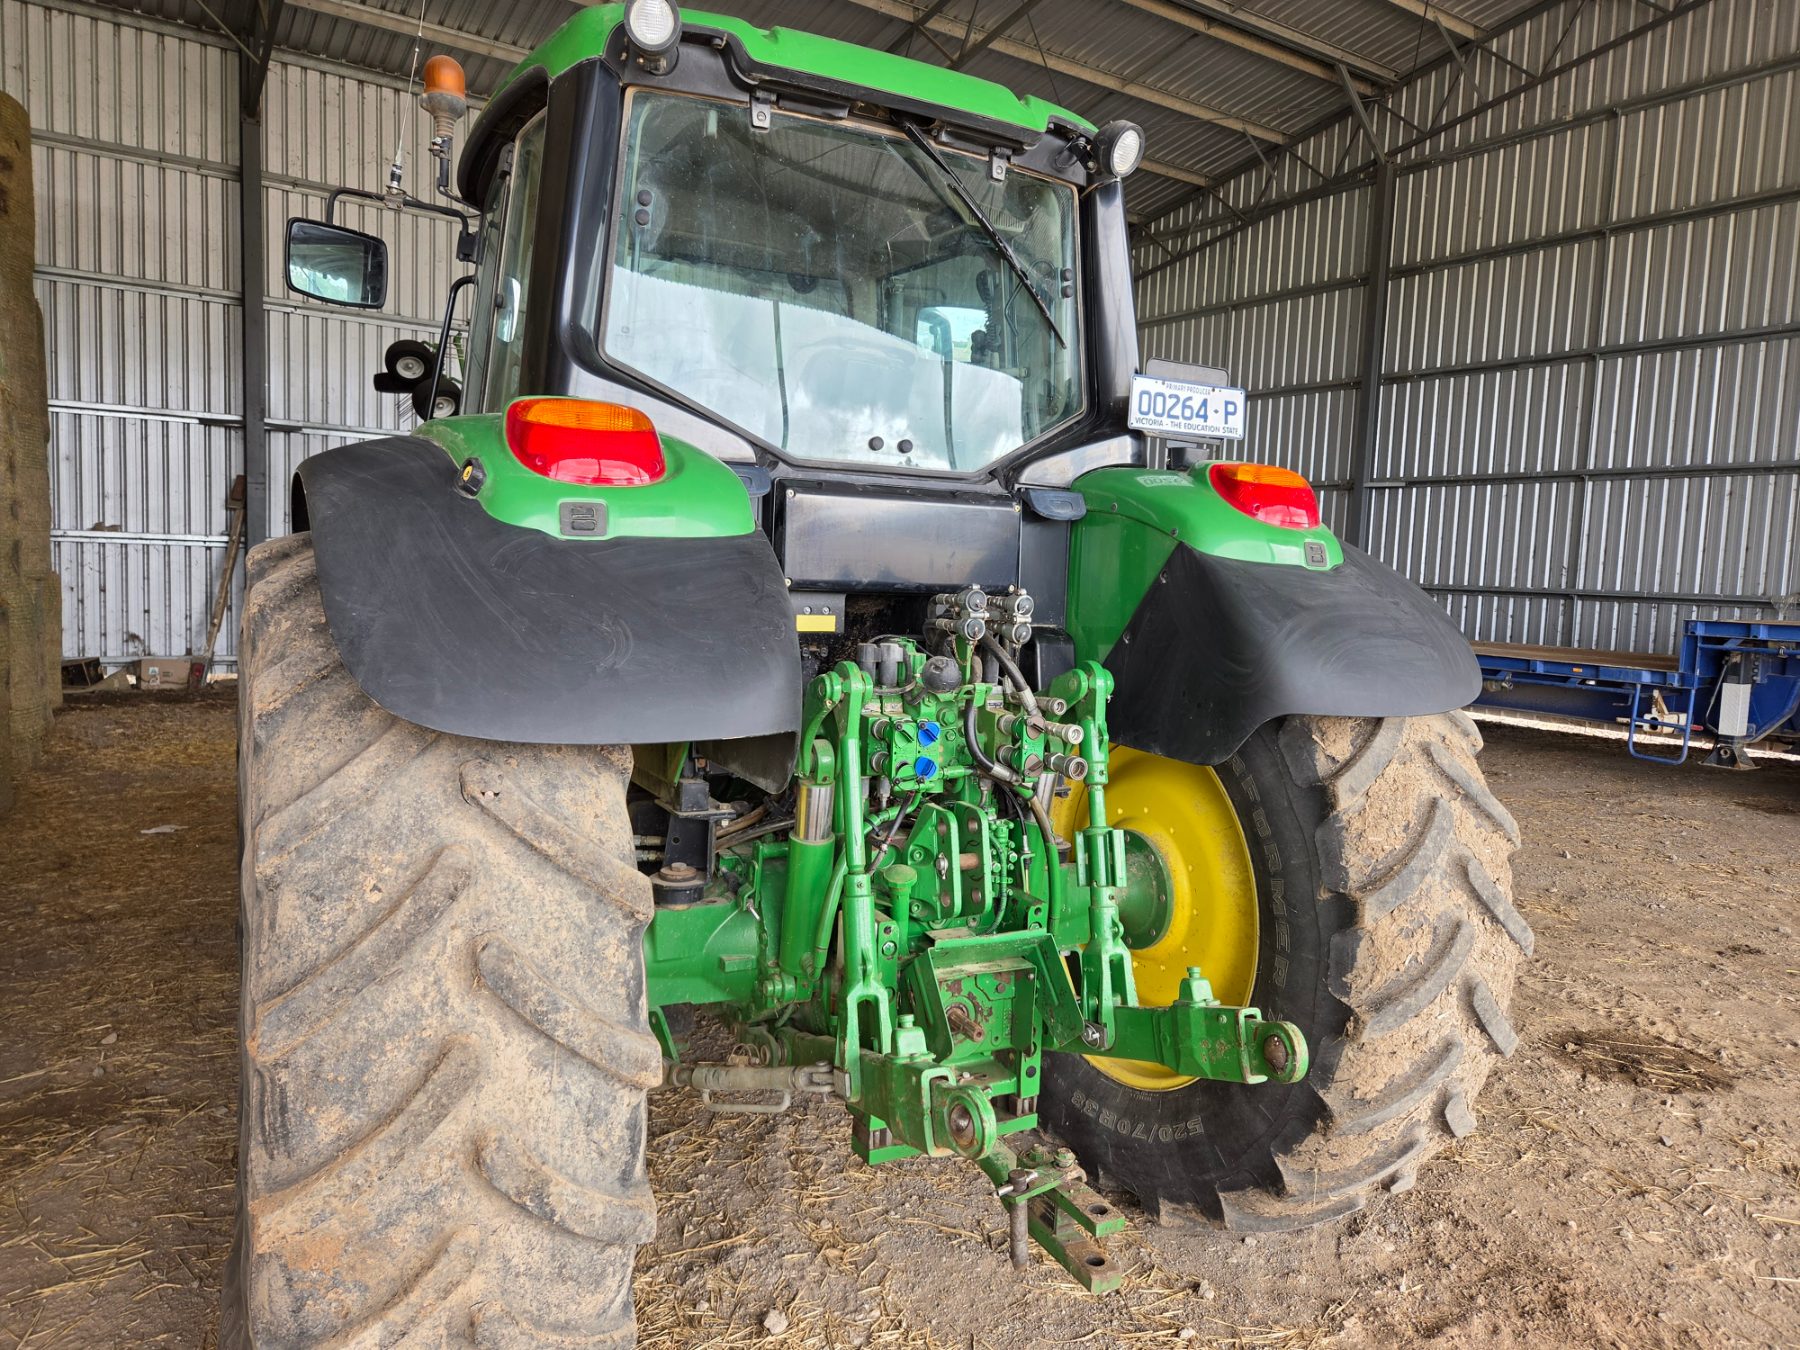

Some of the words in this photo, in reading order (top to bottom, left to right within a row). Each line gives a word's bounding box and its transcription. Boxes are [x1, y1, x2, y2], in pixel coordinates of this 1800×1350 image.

[1165, 382, 1187, 392] PRIMARY
[1187, 385, 1211, 396] PRODUCER
[1135, 416, 1164, 426] VICTORIA
[1170, 420, 1182, 430] THE
[1184, 422, 1220, 433] EDUCATION
[1222, 425, 1239, 435] STATE
[1228, 754, 1290, 988] RFORMER
